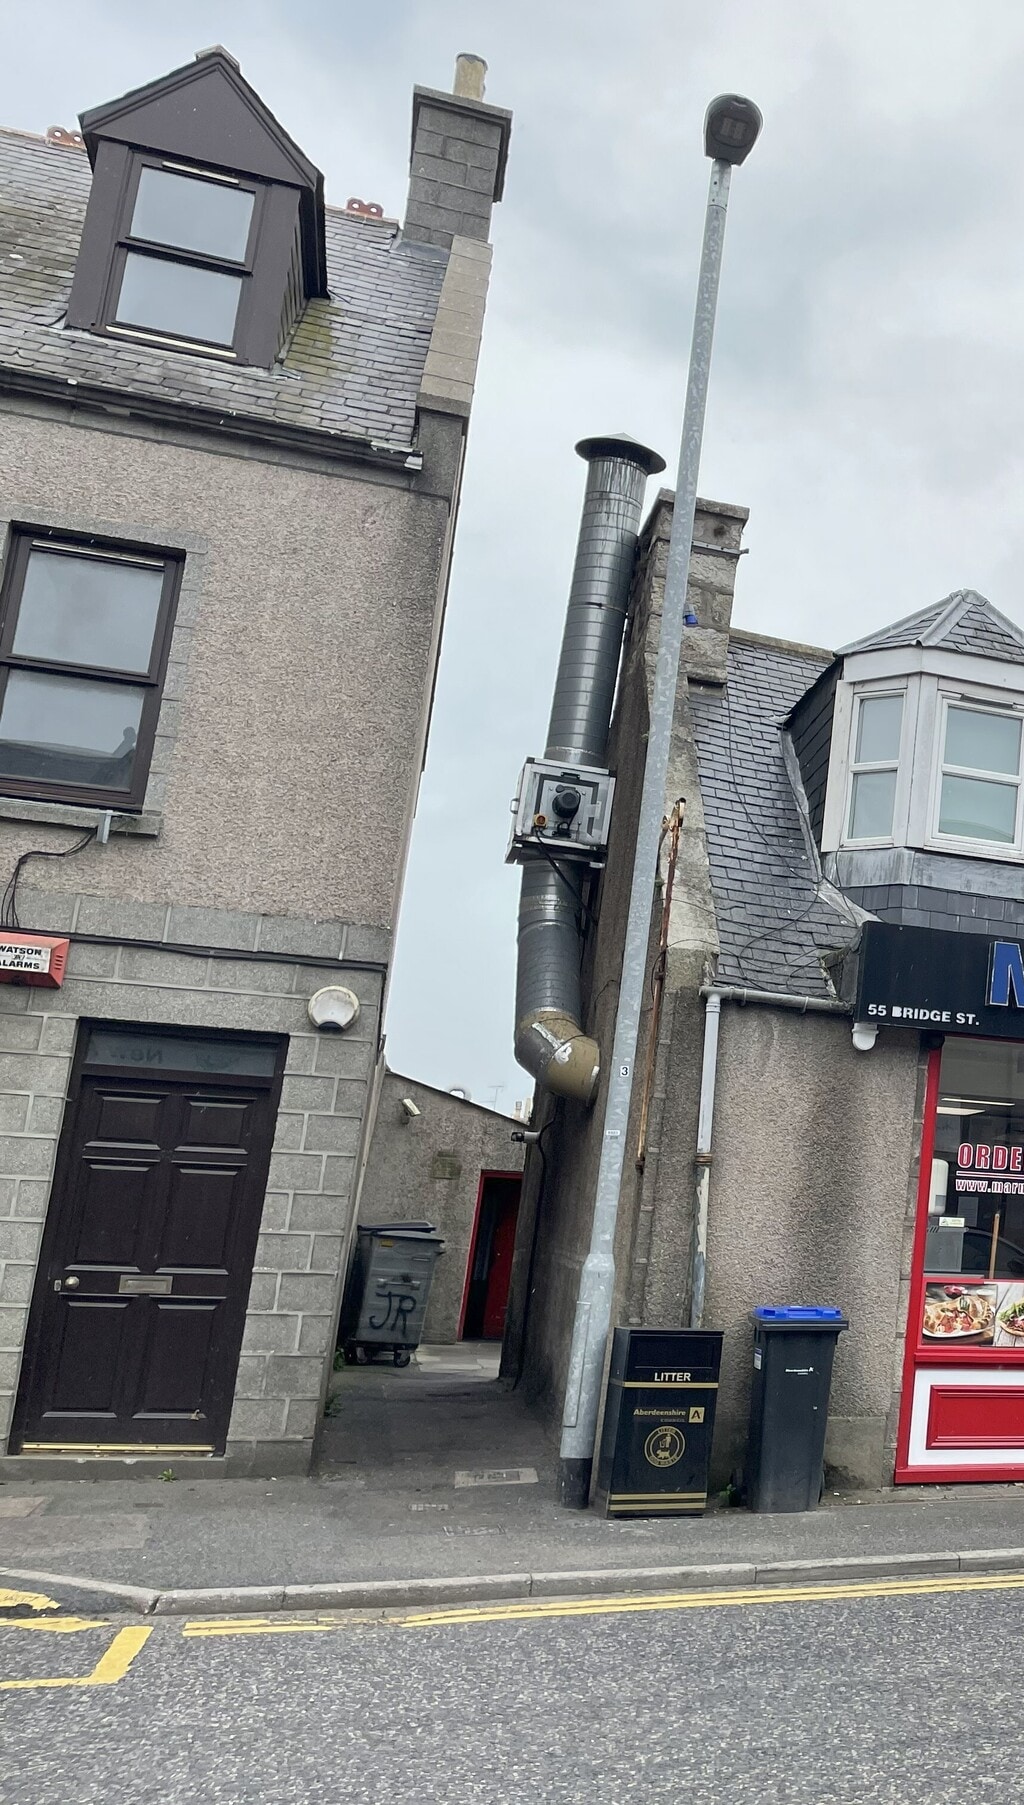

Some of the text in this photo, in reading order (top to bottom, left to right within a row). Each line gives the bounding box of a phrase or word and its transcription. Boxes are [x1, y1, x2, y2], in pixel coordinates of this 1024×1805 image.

[0, 945, 42, 956] WATSON
[0, 959, 40, 970] LARMS
[867, 1003, 980, 1026] 55 BRIDGE ST.
[621, 1066, 629, 1076] 3
[369, 1291, 417, 1336] JR
[654, 1372, 691, 1382] LITTER
[633, 1408, 686, 1416] Aberdeenshire
